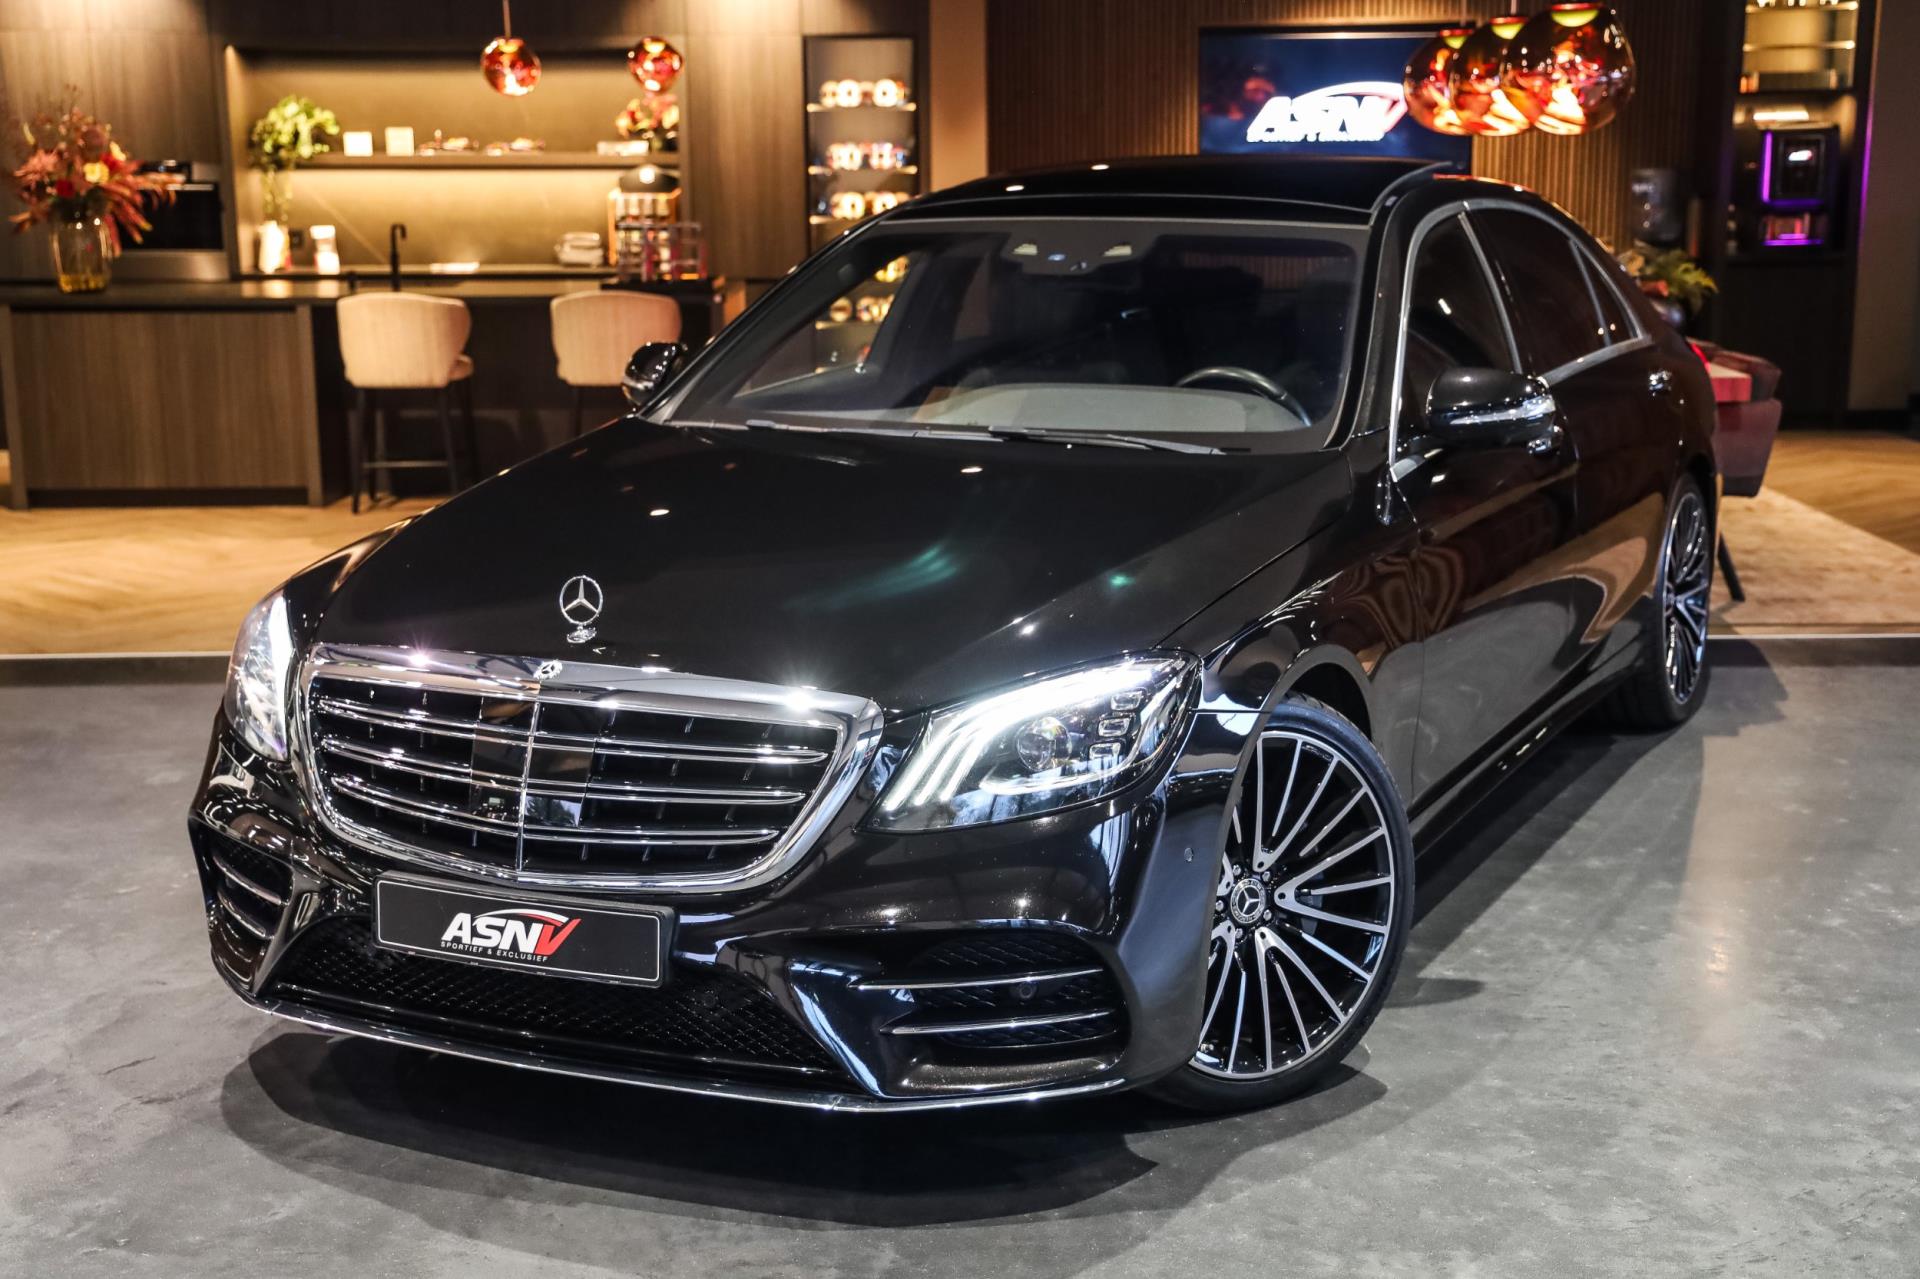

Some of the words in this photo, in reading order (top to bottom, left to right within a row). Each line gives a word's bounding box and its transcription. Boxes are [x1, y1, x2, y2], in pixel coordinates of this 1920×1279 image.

[441, 911, 582, 956] ASNV
[440, 941, 483, 953] SPORTIEF
[496, 950, 548, 962] EXCLUSIEF
